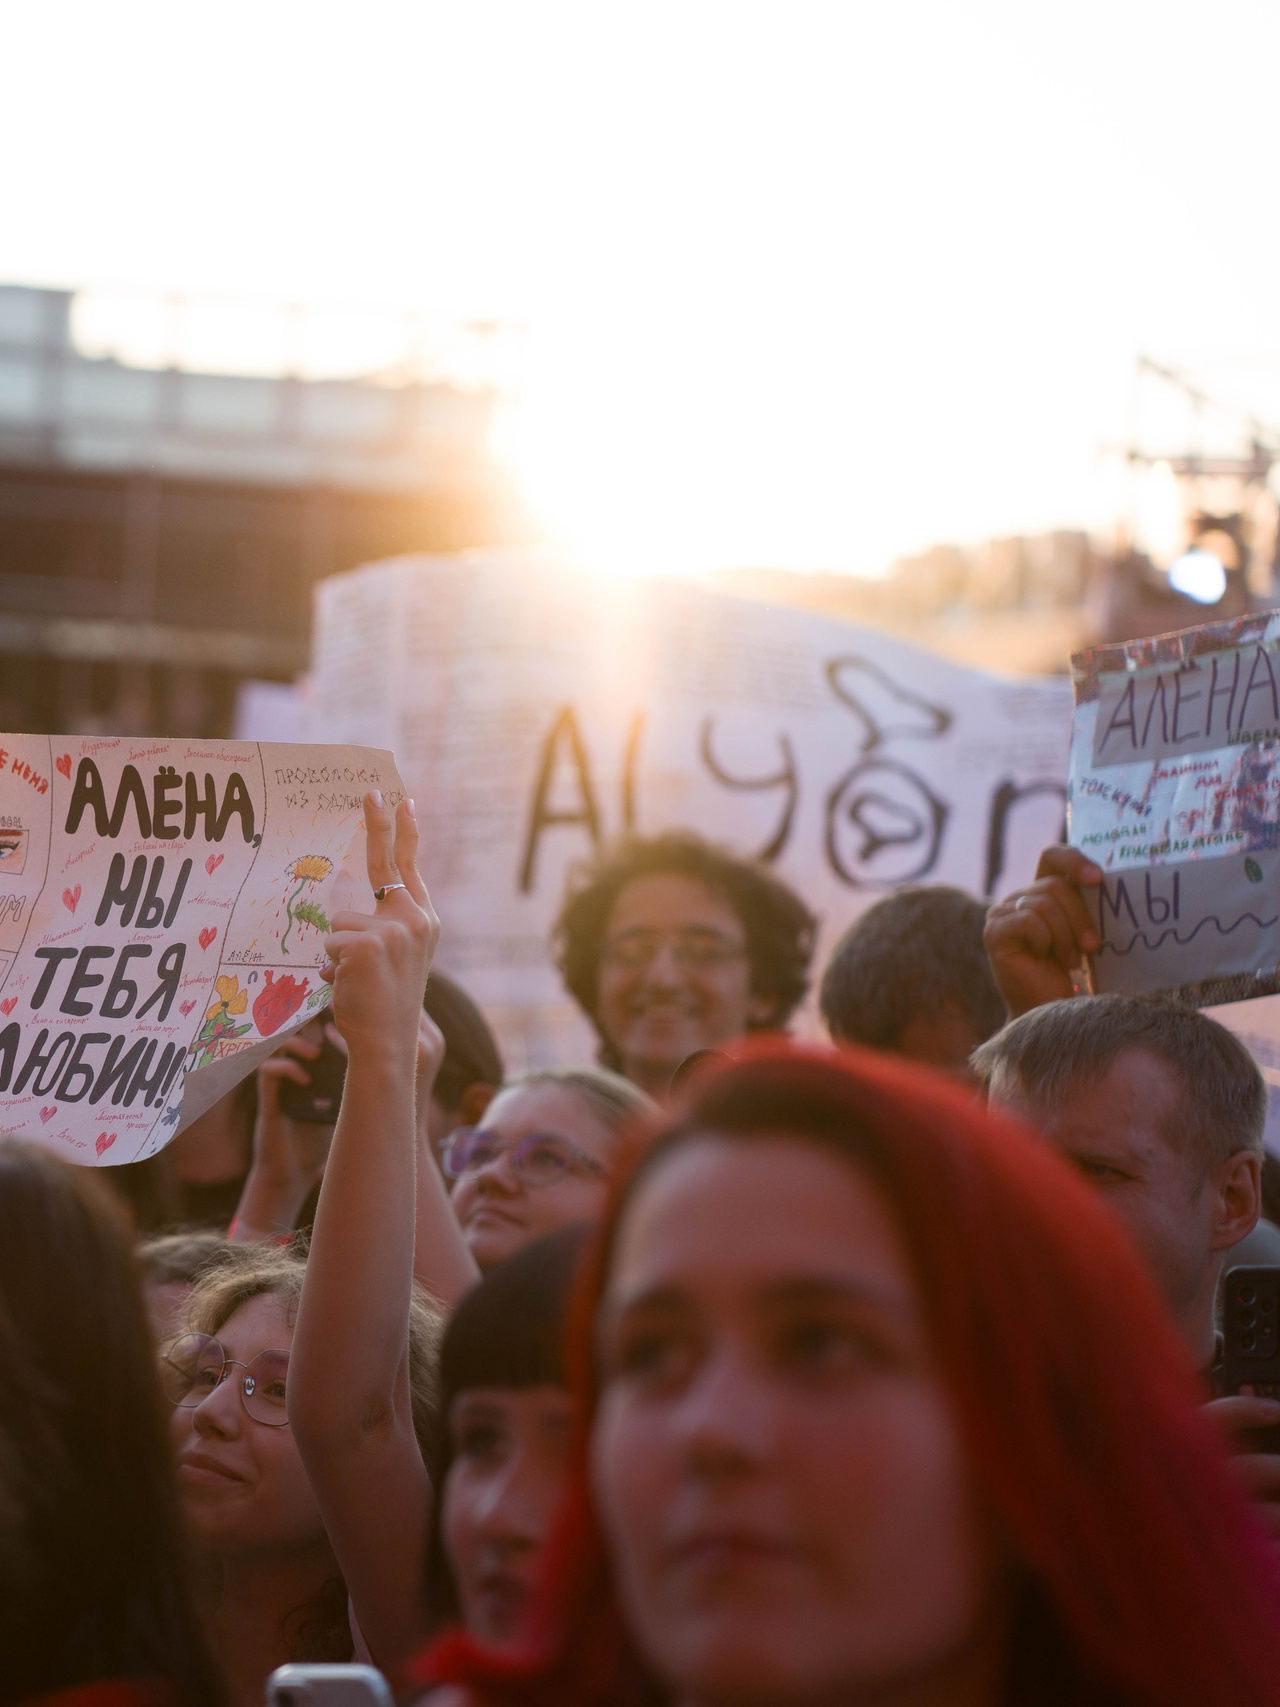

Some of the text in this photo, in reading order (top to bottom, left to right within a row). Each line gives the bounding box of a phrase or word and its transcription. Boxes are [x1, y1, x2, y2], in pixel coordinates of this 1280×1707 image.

[1097, 645, 1280, 754] АЛЁНА
[11, 758, 48, 795] МЕНЯ
[64, 757, 263, 849] АЛЁНА,
[275, 766, 381, 785] ПРОВОЛОКА
[95, 853, 193, 929] МЫ
[1098, 870, 1180, 940] МЫ
[30, 943, 187, 1022] ТЕБЯ
